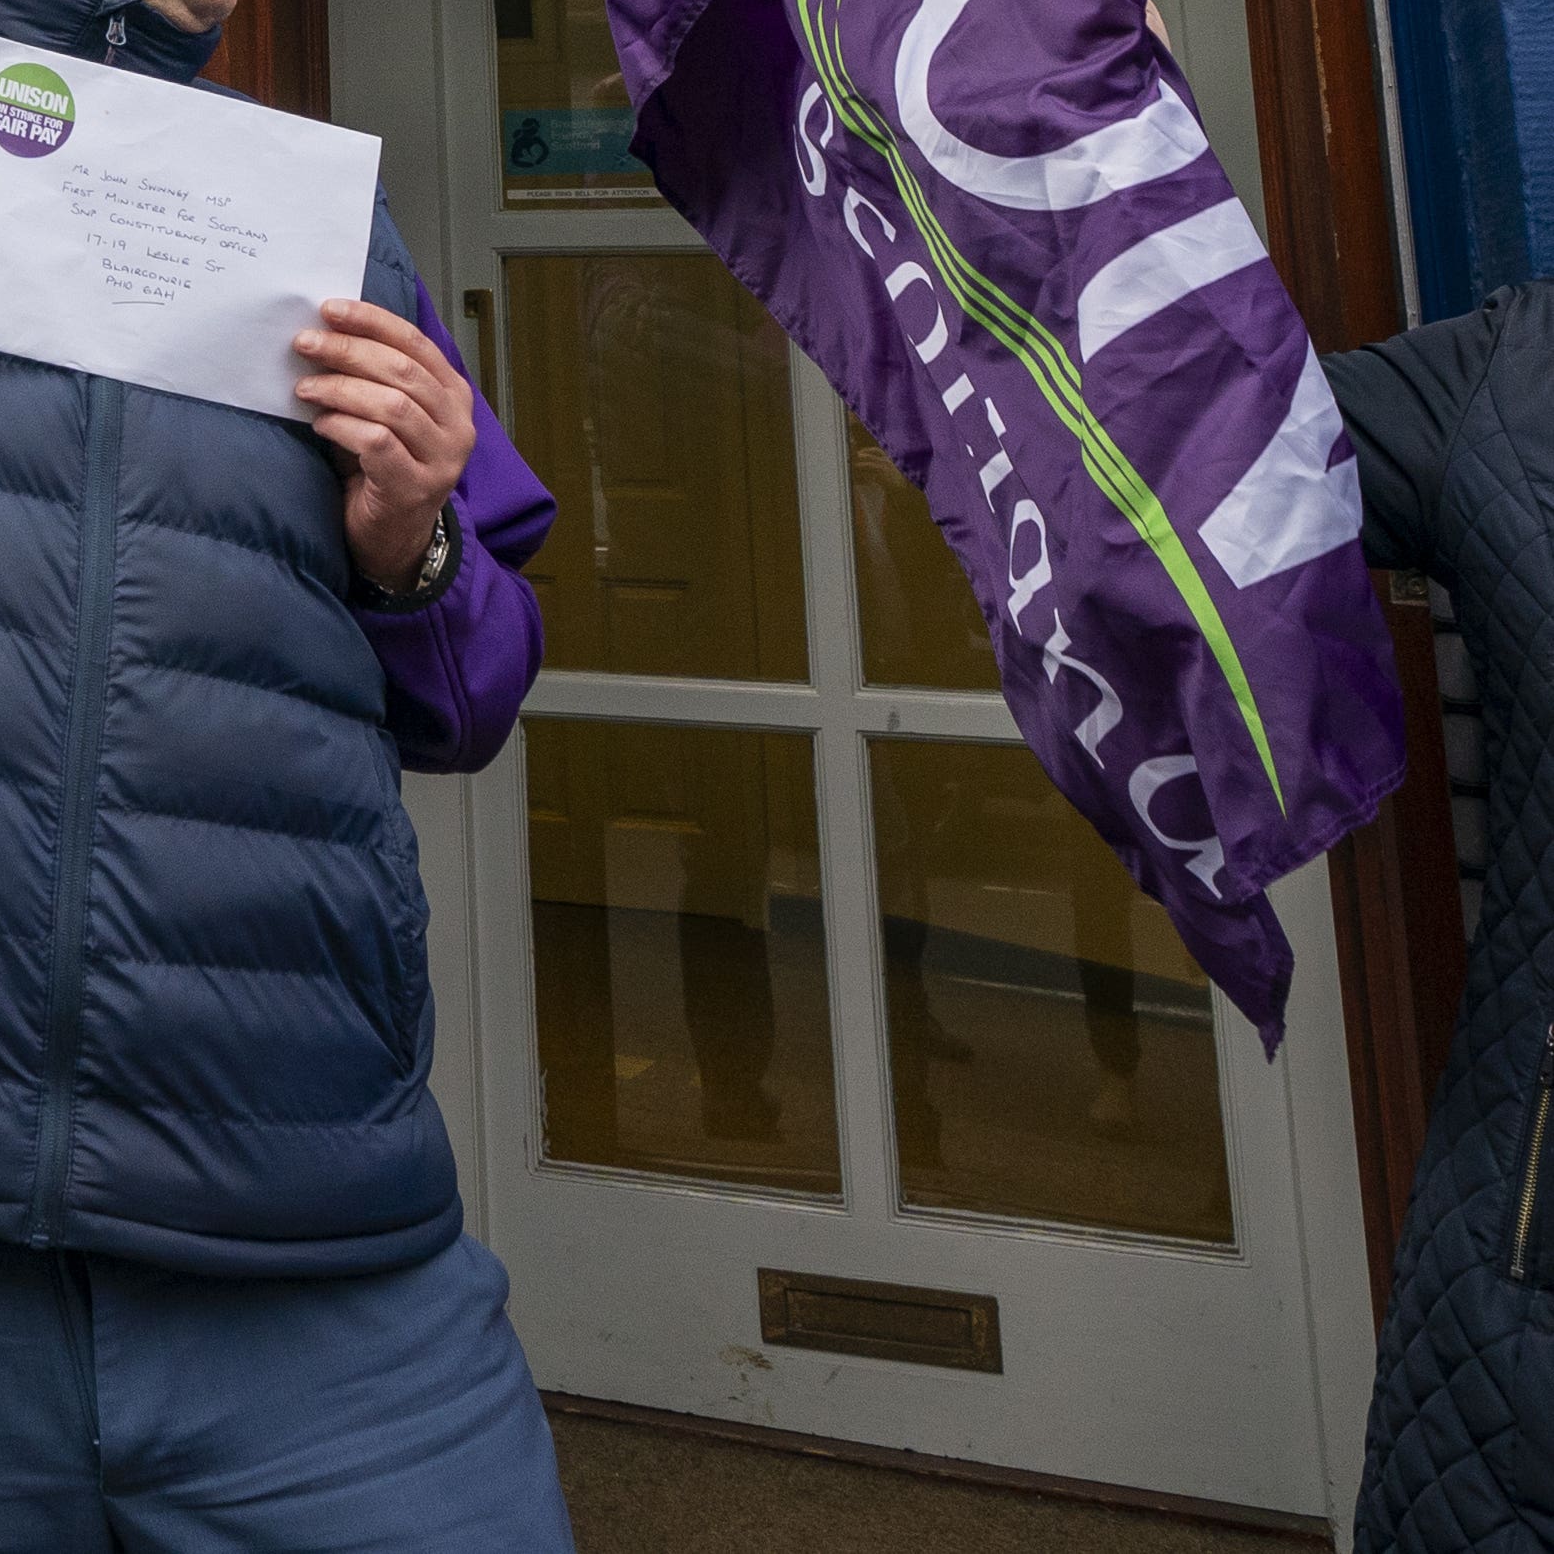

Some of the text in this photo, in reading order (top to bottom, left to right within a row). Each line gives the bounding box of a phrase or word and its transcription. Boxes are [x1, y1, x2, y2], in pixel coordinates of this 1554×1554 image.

[9, 106, 43, 124] STRIKE
[44, 115, 63, 131] FOR
[29, 123, 62, 146] PAY
